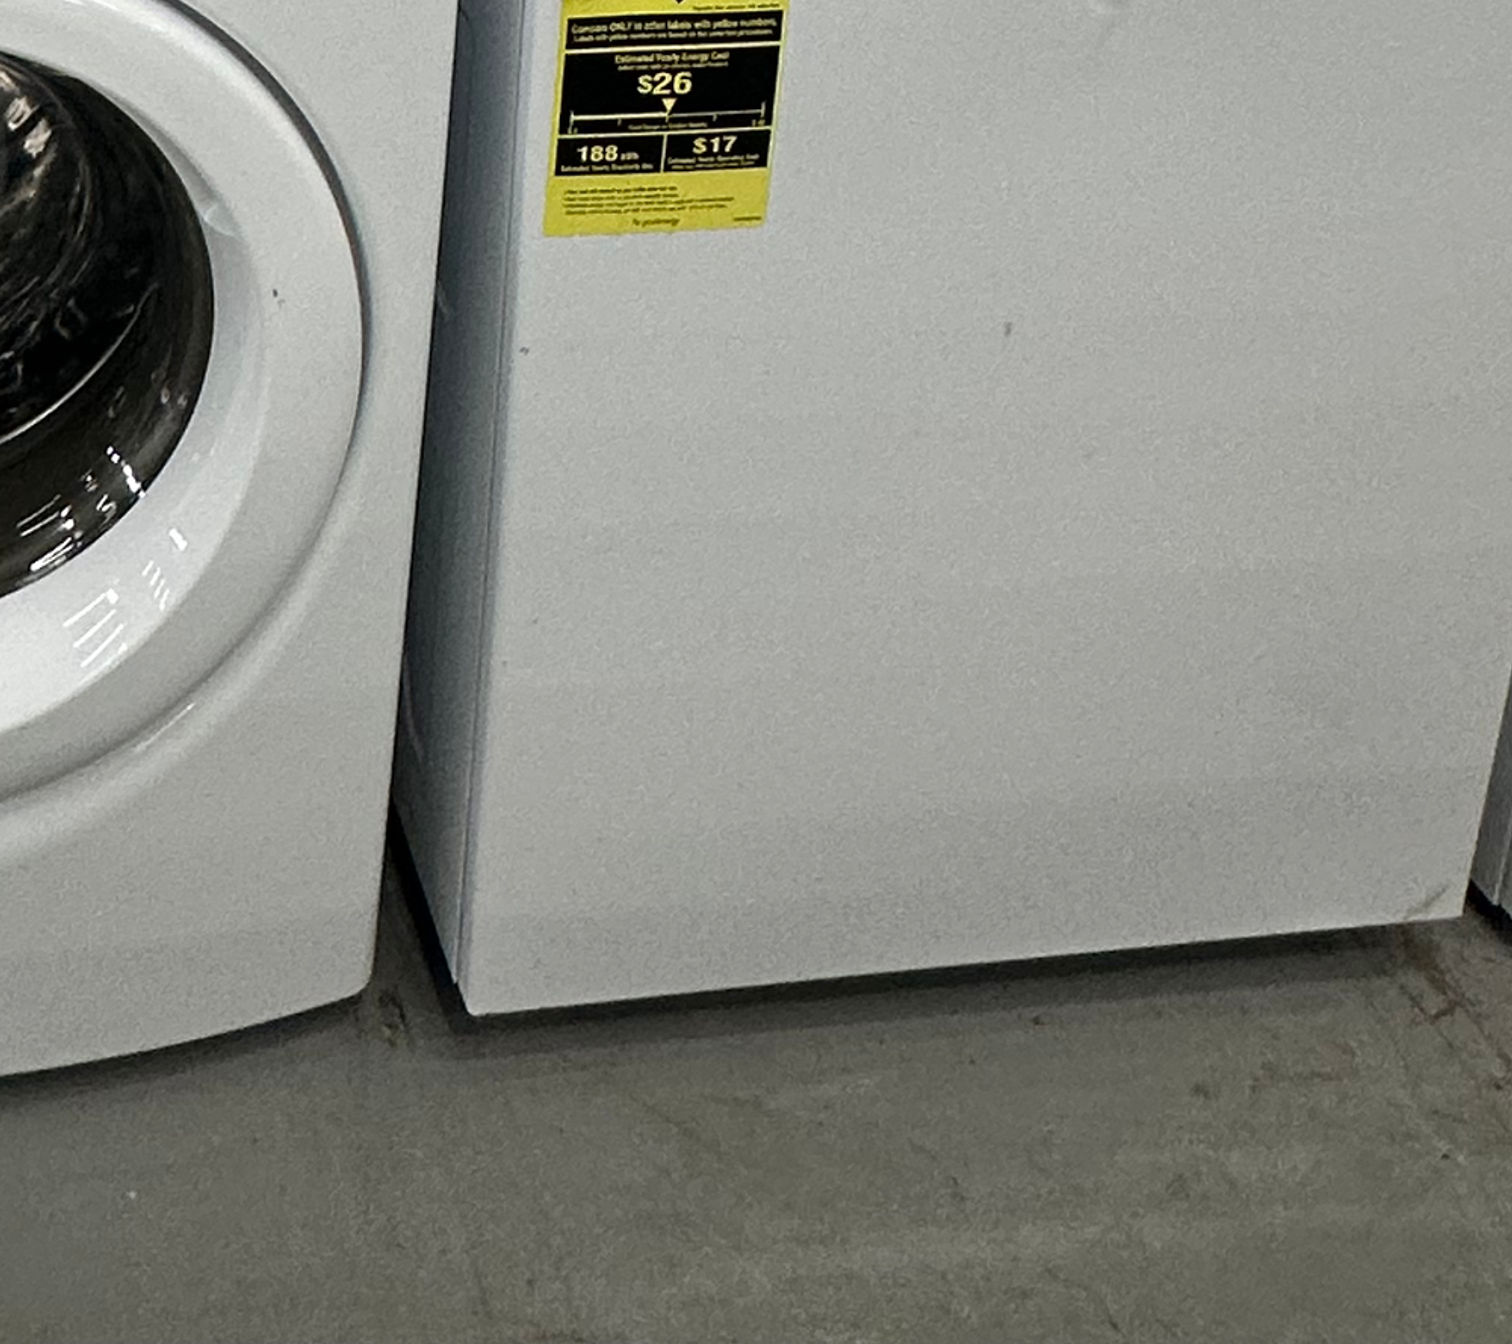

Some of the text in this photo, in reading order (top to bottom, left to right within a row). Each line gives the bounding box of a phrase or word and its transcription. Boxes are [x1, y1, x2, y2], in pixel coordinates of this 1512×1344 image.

[609, 22, 633, 33] ONLY
[713, 18, 738, 30] yellow
[614, 53, 654, 64] Estimated
[711, 50, 731, 60] Cost
[636, 71, 693, 95] $26
[577, 144, 619, 162] 188
[692, 135, 738, 154] $17
